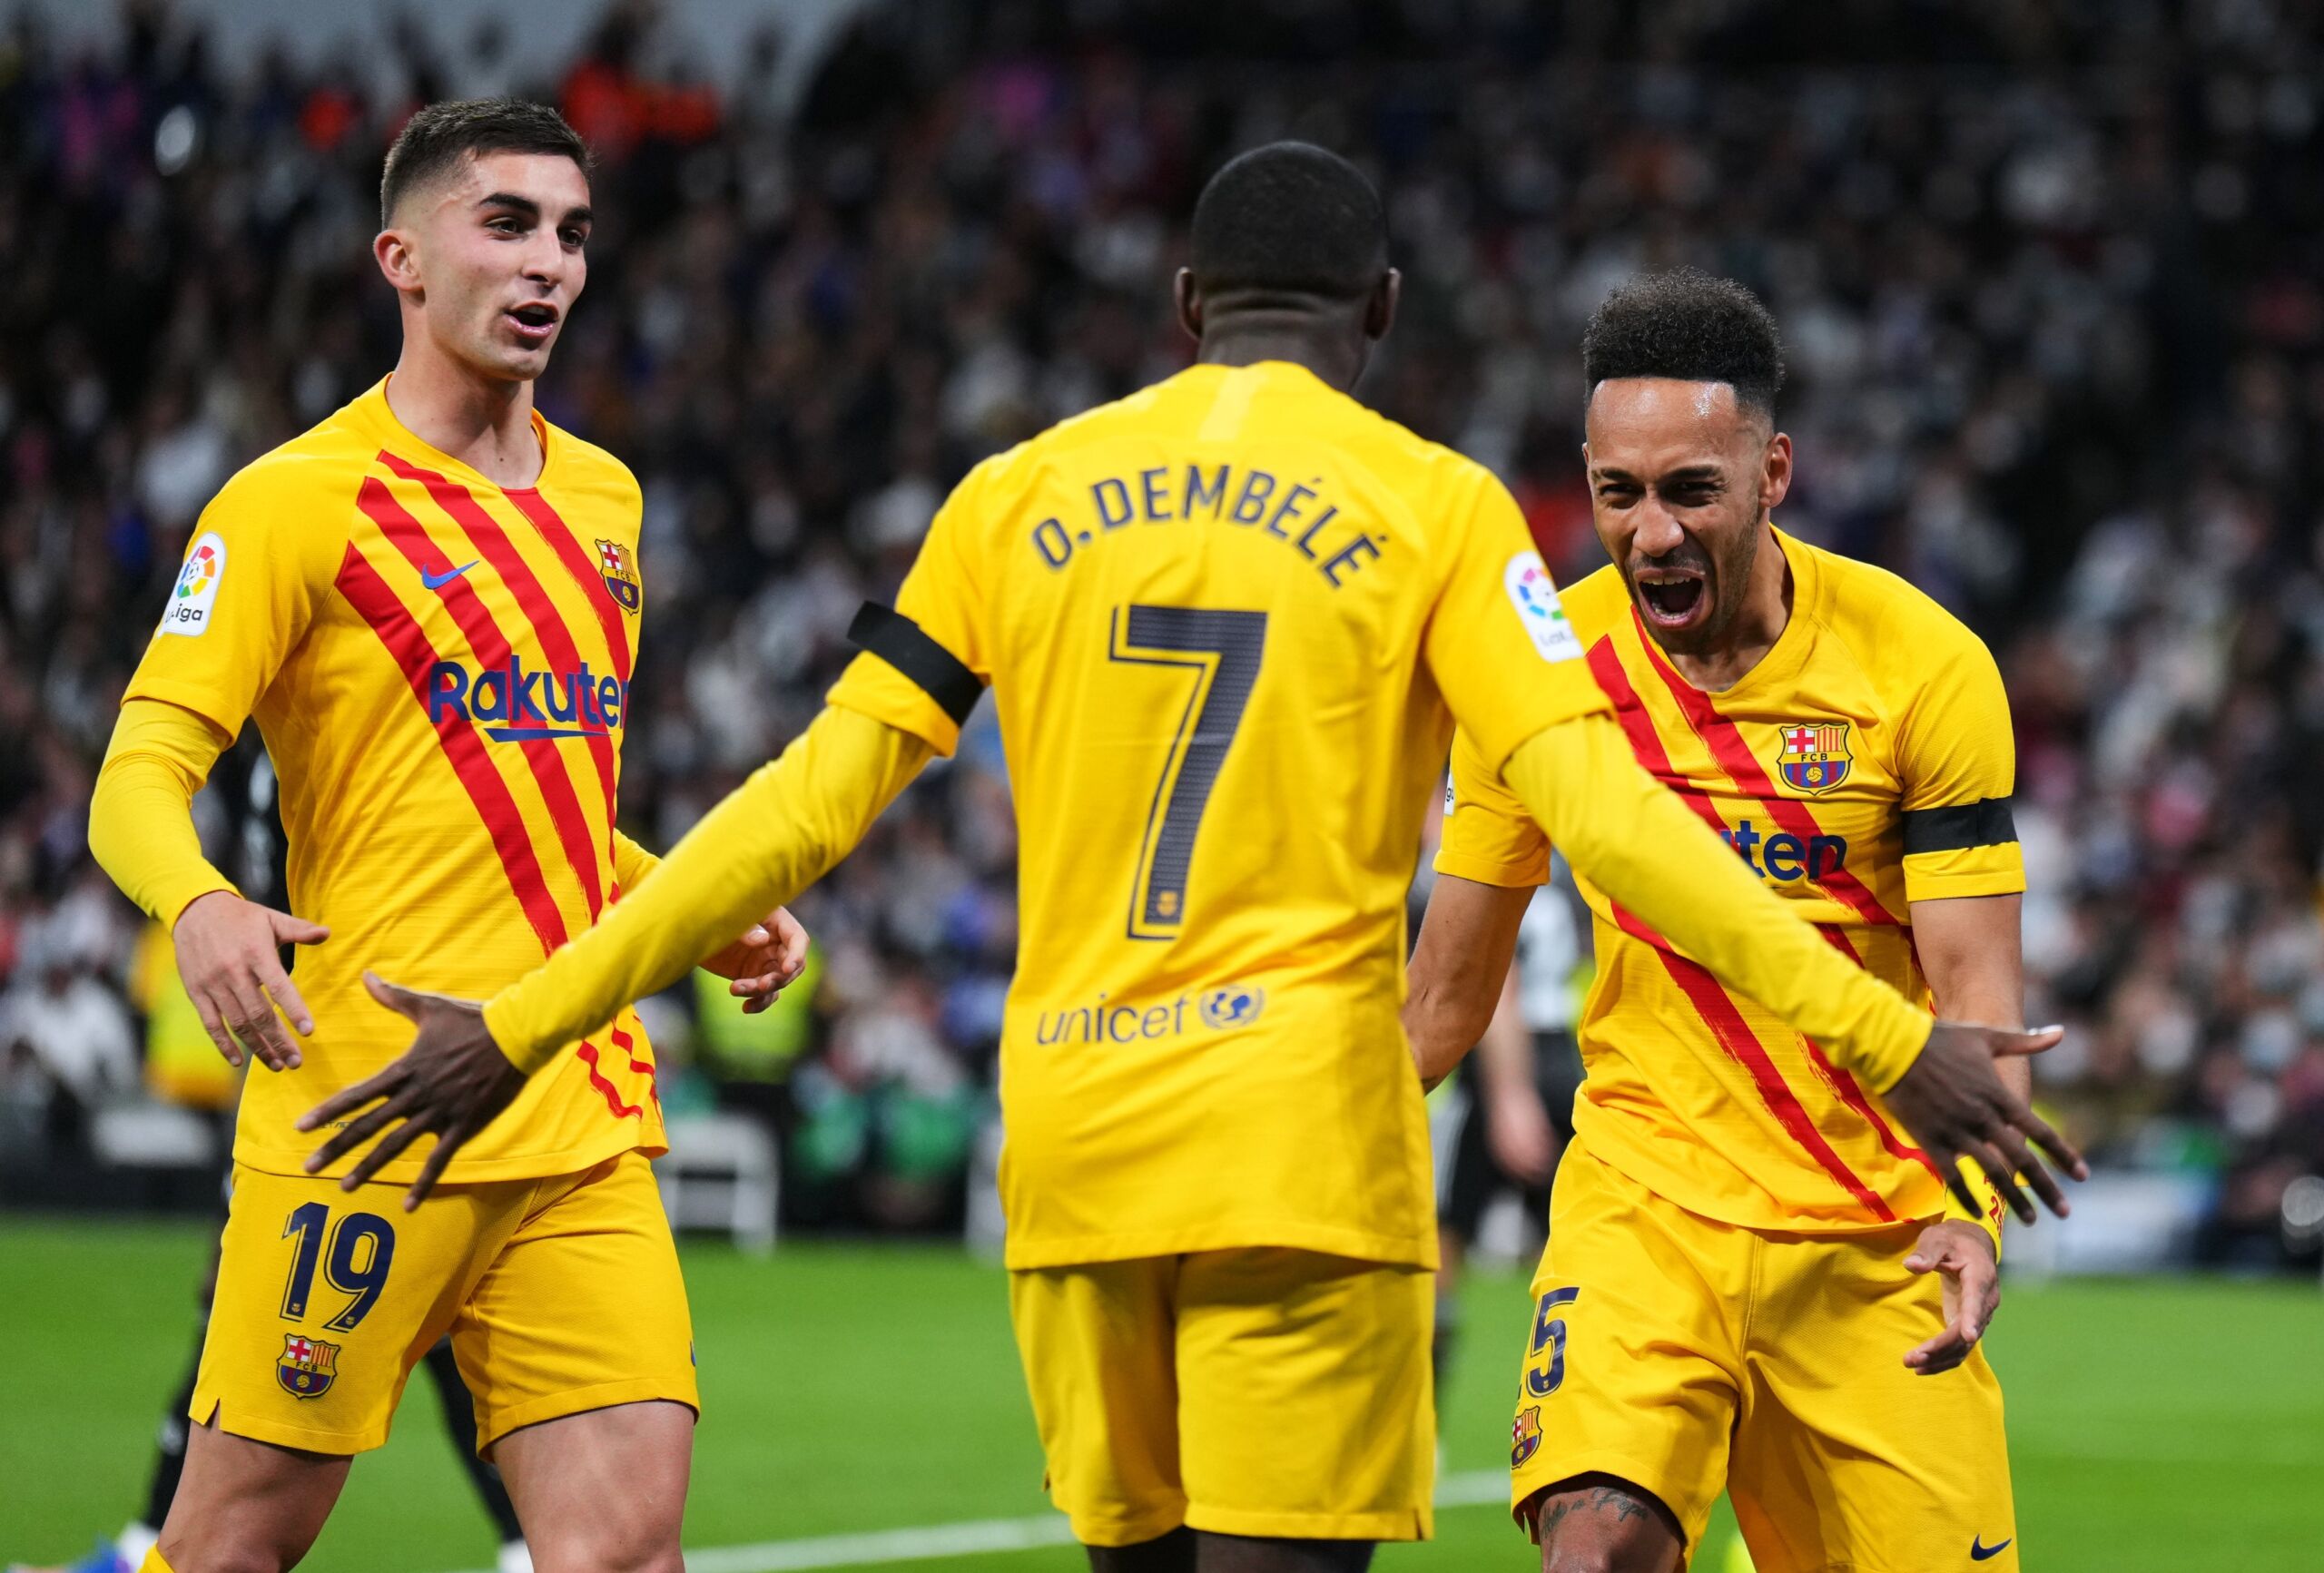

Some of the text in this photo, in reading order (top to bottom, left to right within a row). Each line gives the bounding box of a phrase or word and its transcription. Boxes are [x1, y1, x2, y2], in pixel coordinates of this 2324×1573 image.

[1032, 464, 1388, 590] O.DEMBÉLÉ
[1108, 604, 1267, 940] 7
[1800, 752, 1828, 762] FCB
[1037, 988, 1193, 1046] unicef
[279, 1201, 396, 1334] 19
[295, 1361, 319, 1373] FCB
